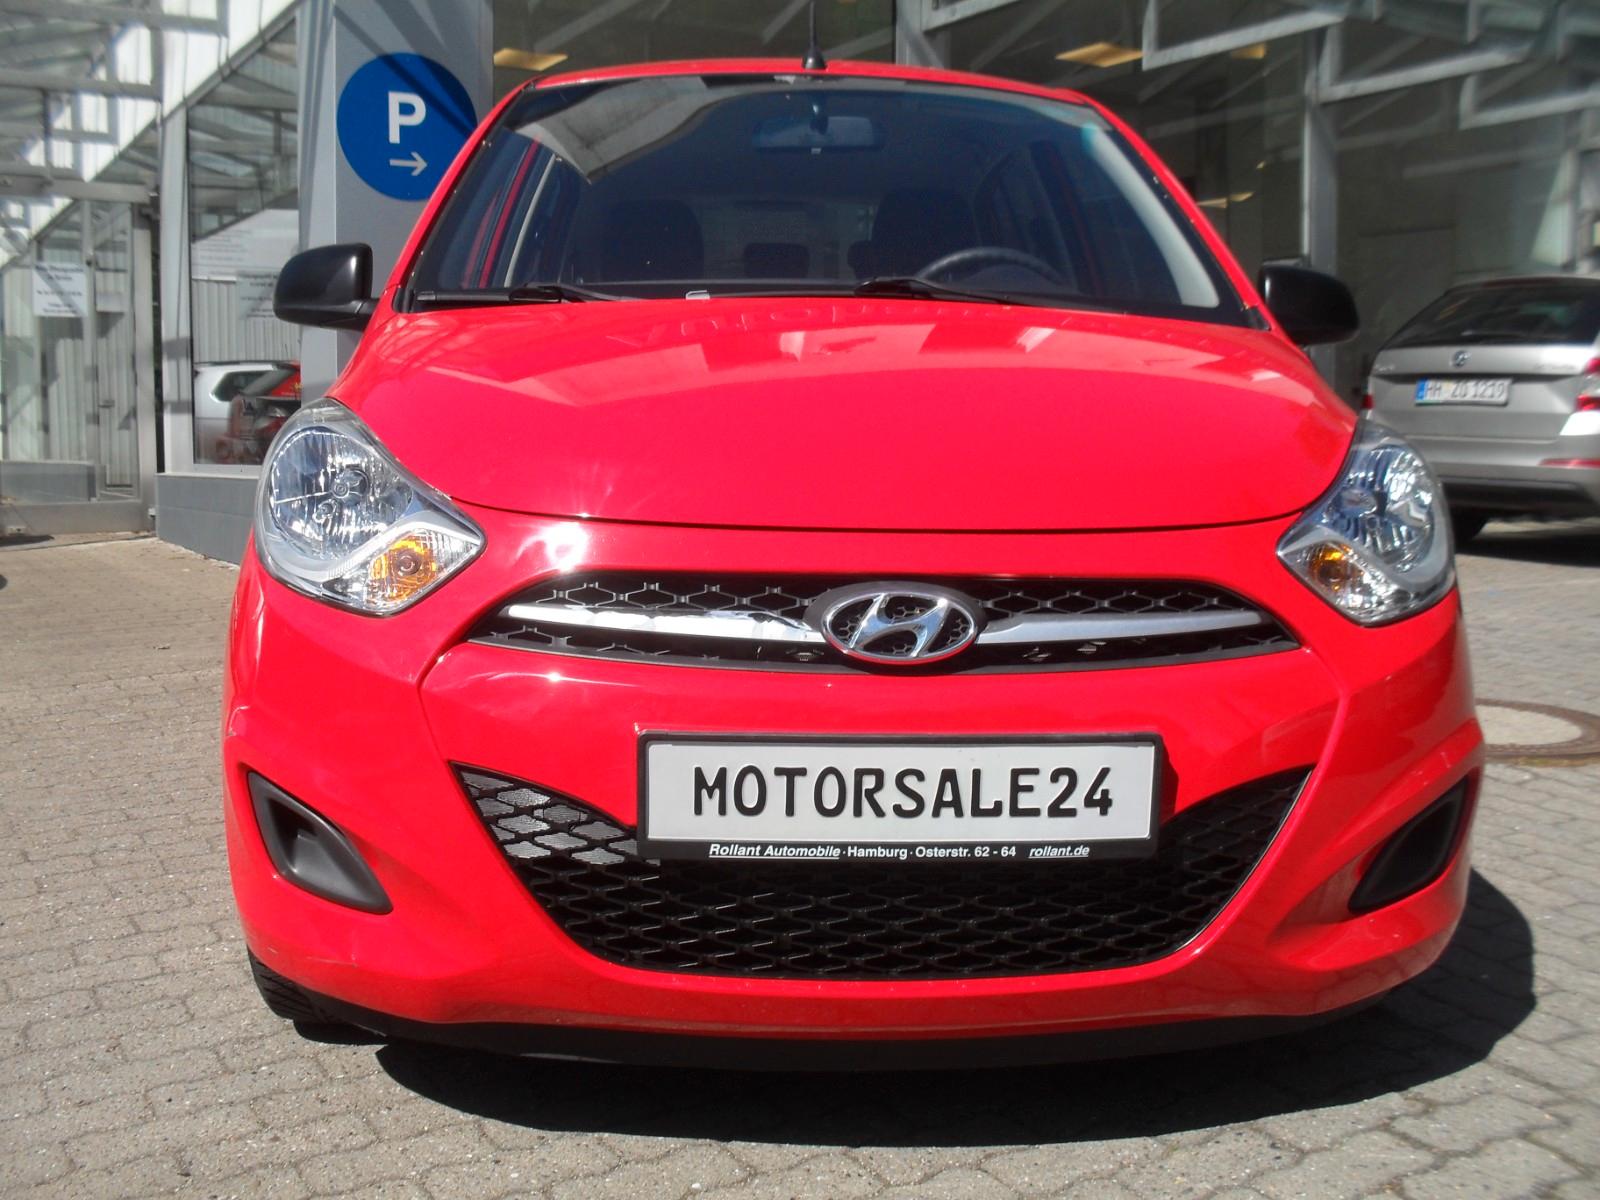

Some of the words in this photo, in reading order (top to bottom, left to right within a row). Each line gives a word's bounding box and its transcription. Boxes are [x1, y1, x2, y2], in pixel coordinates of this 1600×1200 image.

[388, 91, 427, 144] P
[693, 764, 1113, 818] MOTORSALE24
[709, 843, 761, 856] Rollant
[763, 844, 841, 857] Automobile
[847, 846, 908, 860] Hamburg
[915, 846, 971, 858] Osterstr.
[974, 847, 990, 858] 62
[1001, 846, 1016, 858] 64
[1028, 845, 1090, 858] rollant.de
